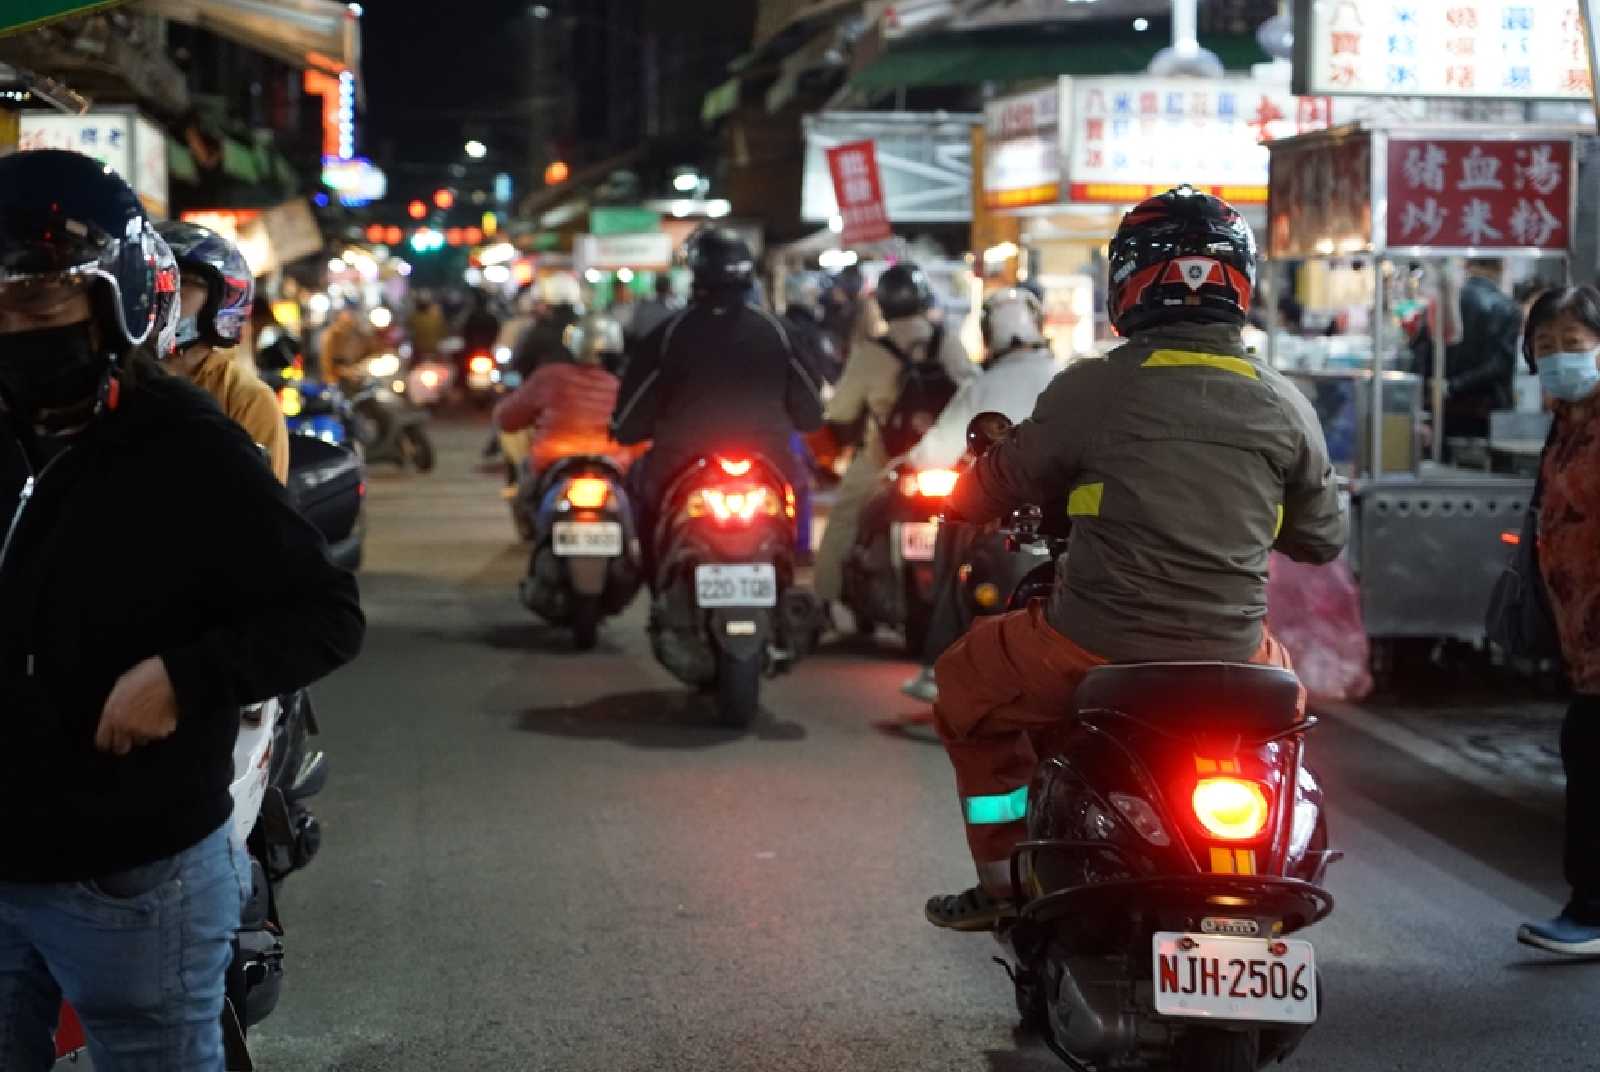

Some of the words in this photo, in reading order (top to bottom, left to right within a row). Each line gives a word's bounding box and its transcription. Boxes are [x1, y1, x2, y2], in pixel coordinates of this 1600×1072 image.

[1400, 198, 1562, 245] 炒米粉
[1159, 953, 1308, 1001] NJH-2506
